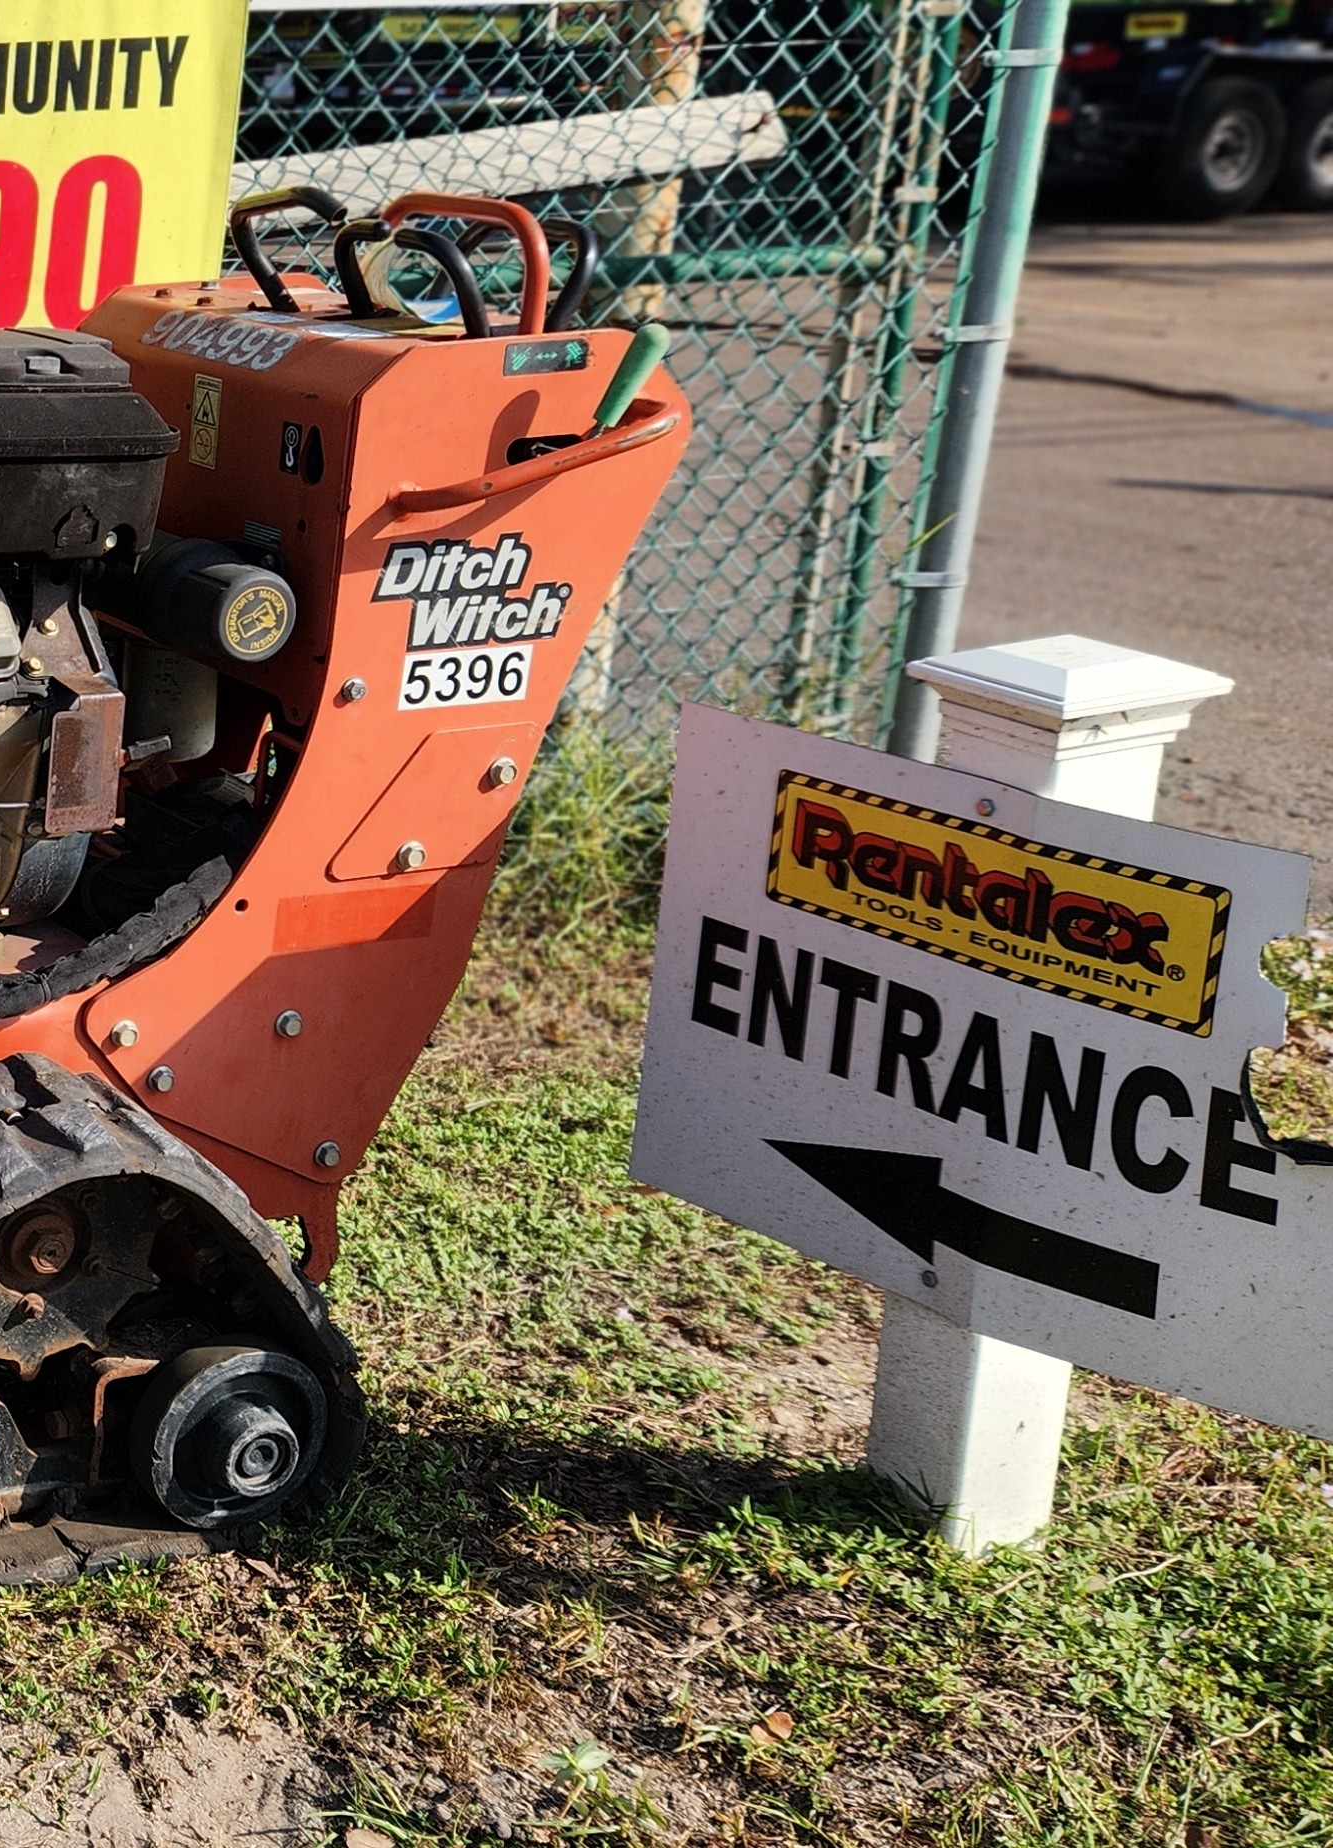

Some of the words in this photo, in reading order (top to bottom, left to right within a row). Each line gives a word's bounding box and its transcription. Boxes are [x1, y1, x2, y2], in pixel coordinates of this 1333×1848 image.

[141, 309, 301, 371] 904993
[378, 539, 528, 596] Ditch
[229, 592, 255, 643] OPERATOR'S
[259, 590, 284, 615] MANUAL
[250, 628, 280, 650] INSIDE
[412, 588, 562, 646] Witch
[404, 651, 525, 705] 5396
[850, 891, 945, 933] TOOLS
[969, 930, 1162, 998] EQUIPMENT
[690, 915, 1279, 1227] ENTRANCE
